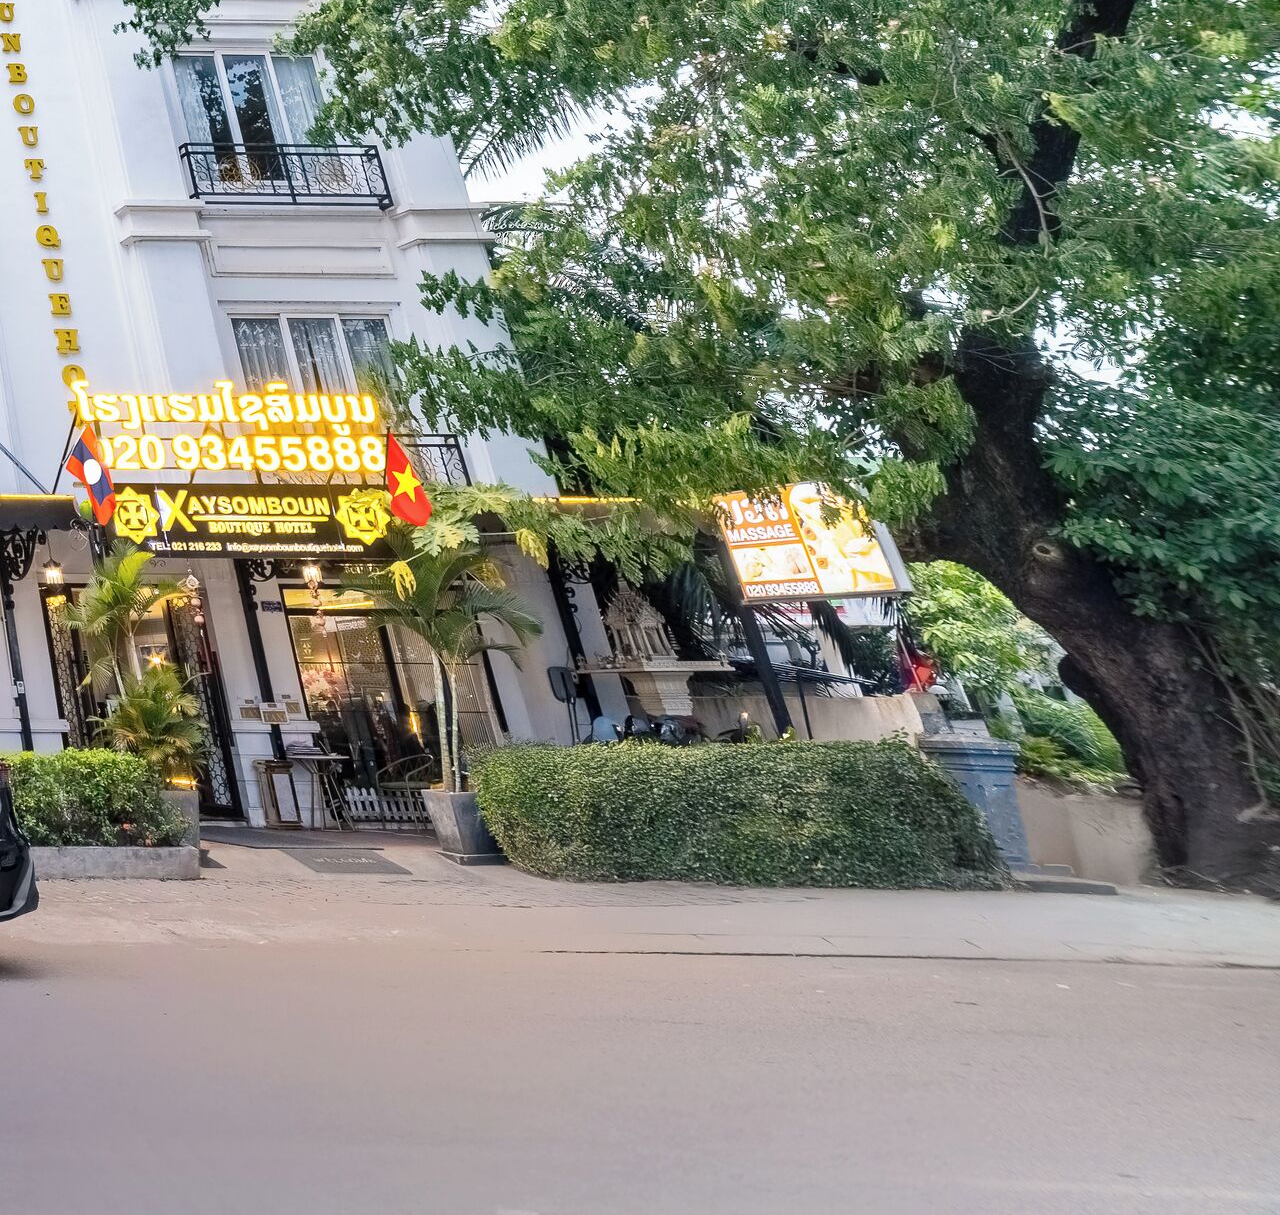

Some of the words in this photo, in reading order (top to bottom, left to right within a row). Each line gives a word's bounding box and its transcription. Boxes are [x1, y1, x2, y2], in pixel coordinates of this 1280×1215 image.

[172, 434, 387, 473] 93455888
[158, 489, 331, 533] XAYSOMBOUN
[209, 521, 272, 537] BOUTIQUE
[274, 522, 317, 535] HOTEL
[726, 524, 796, 543] MASSAGE
